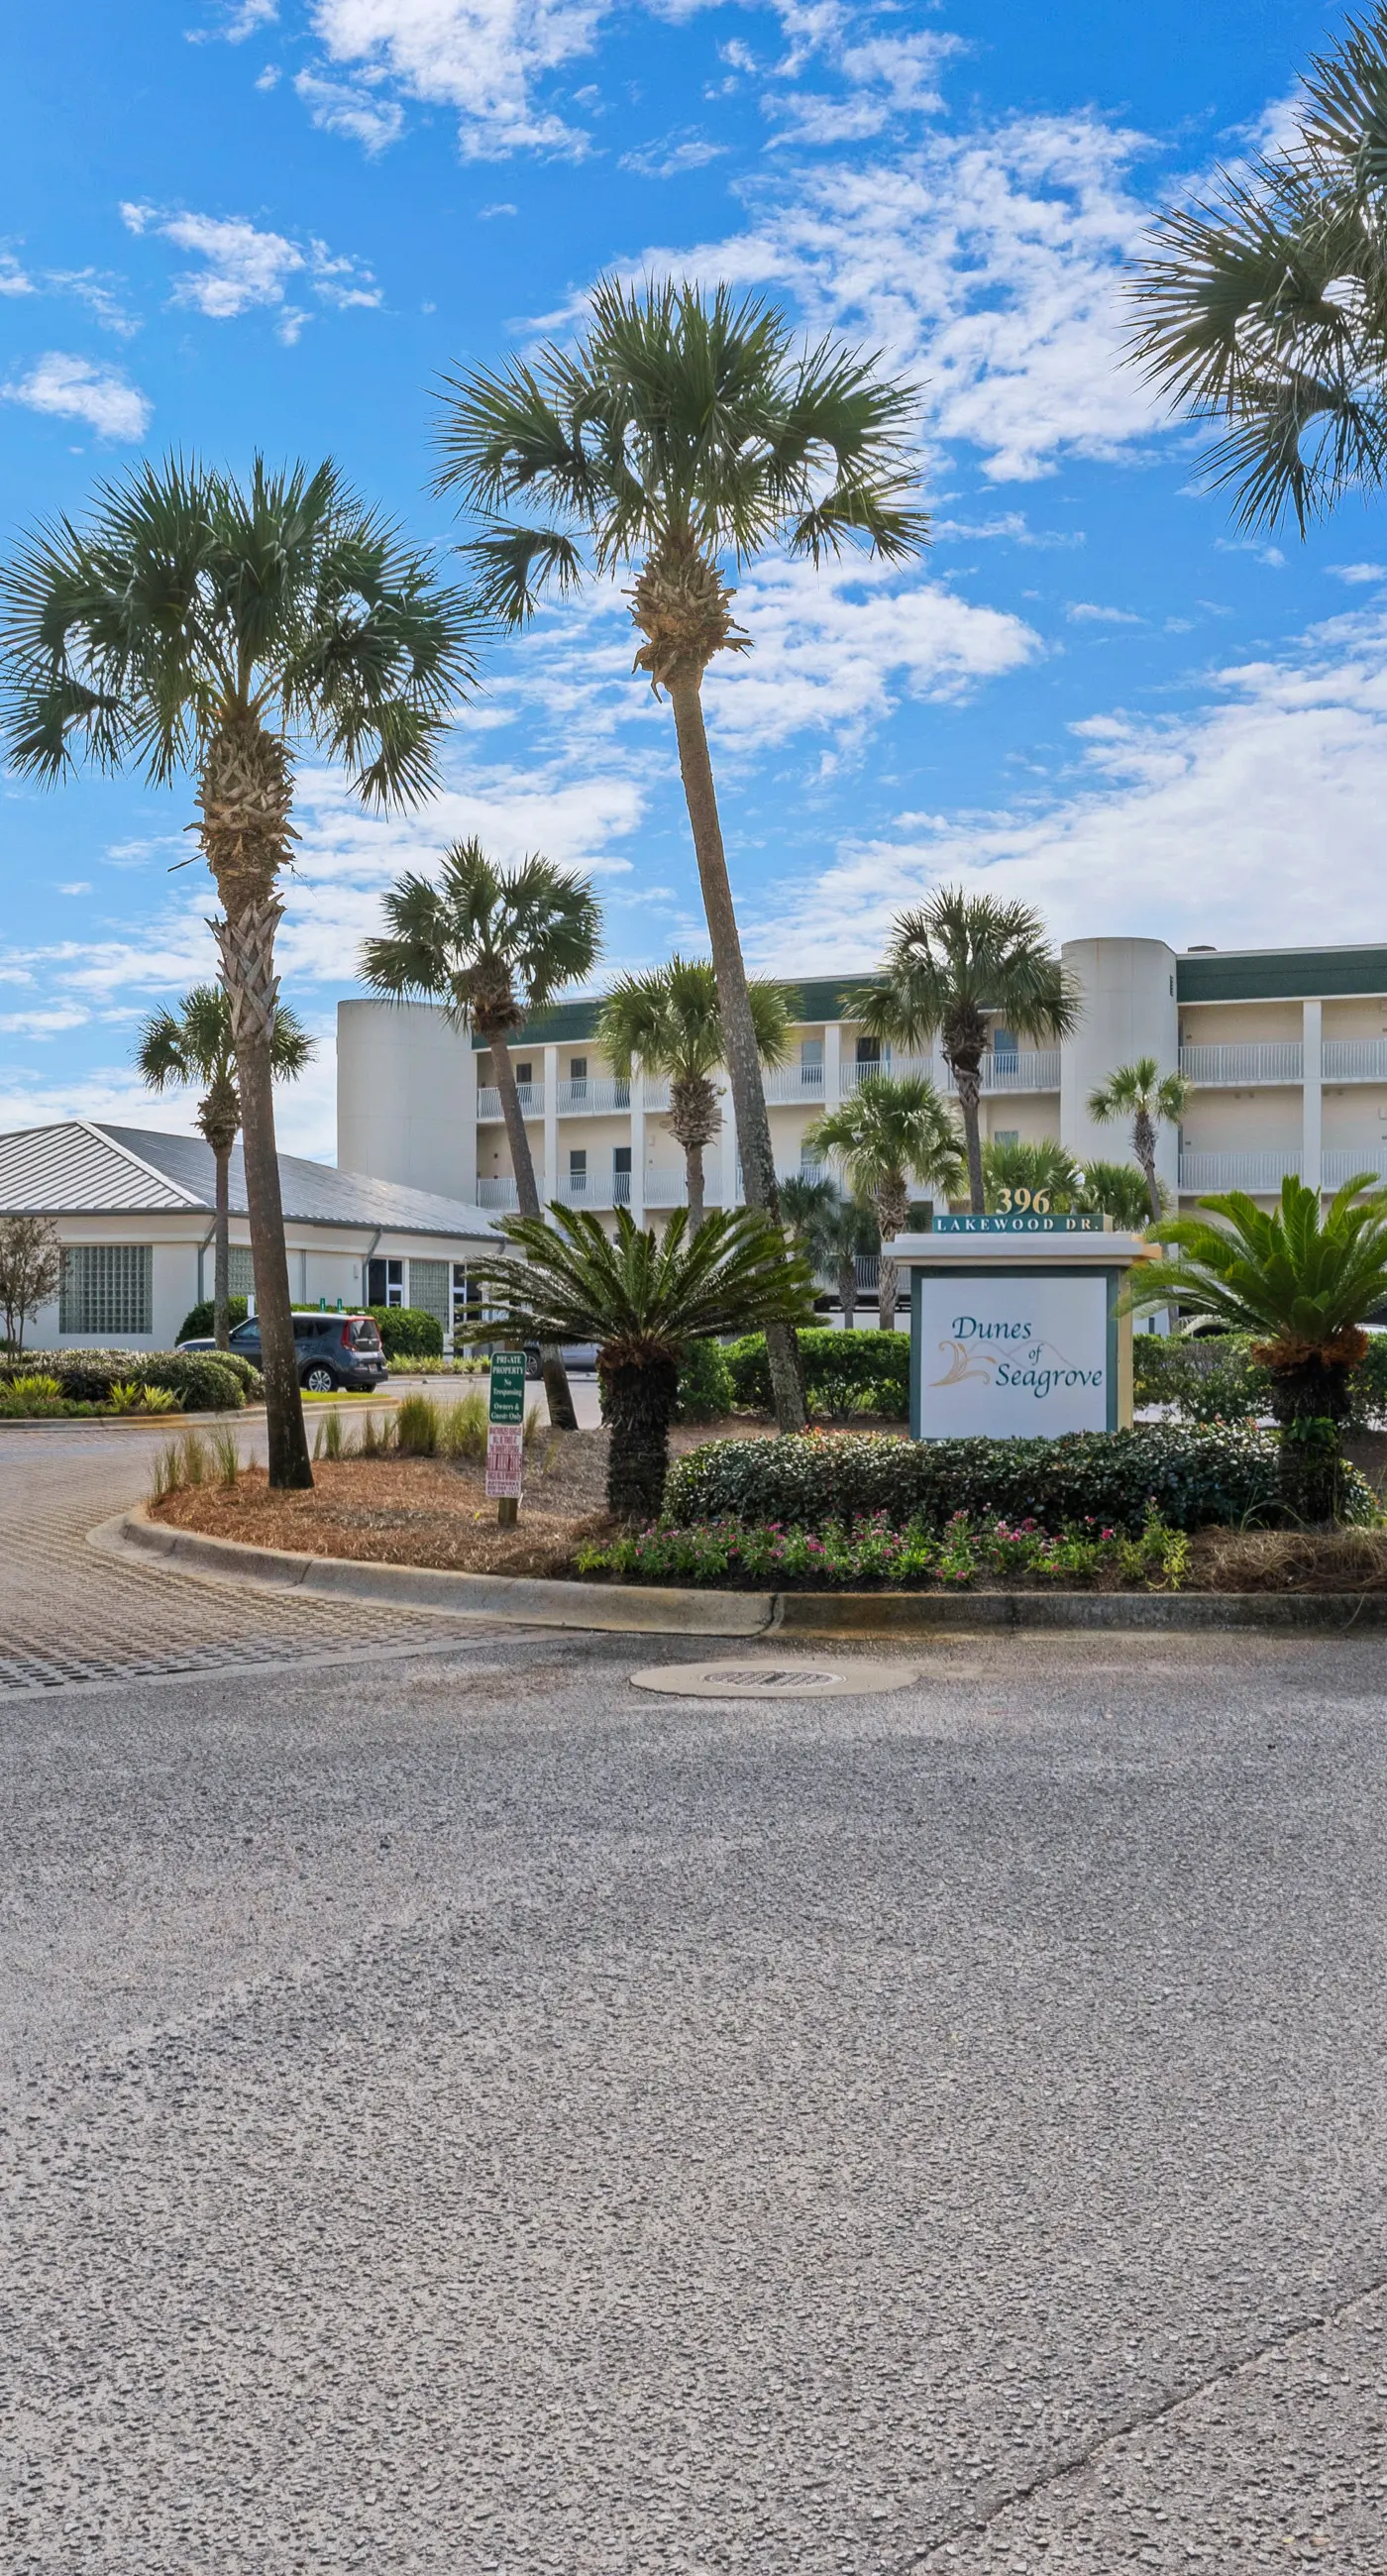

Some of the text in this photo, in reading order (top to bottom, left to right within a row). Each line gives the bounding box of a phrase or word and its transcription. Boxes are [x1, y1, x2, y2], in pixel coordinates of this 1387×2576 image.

[995, 1188, 1051, 1215] 396
[937, 1218, 1100, 1232] LAKEWOOD DR.
[952, 1316, 1032, 1339] Dunes
[496, 1355, 522, 1364] PRIATE
[1028, 1343, 1045, 1366] of
[492, 1366, 523, 1375] PROPERTY
[996, 1363, 1103, 1399] Seagrove
